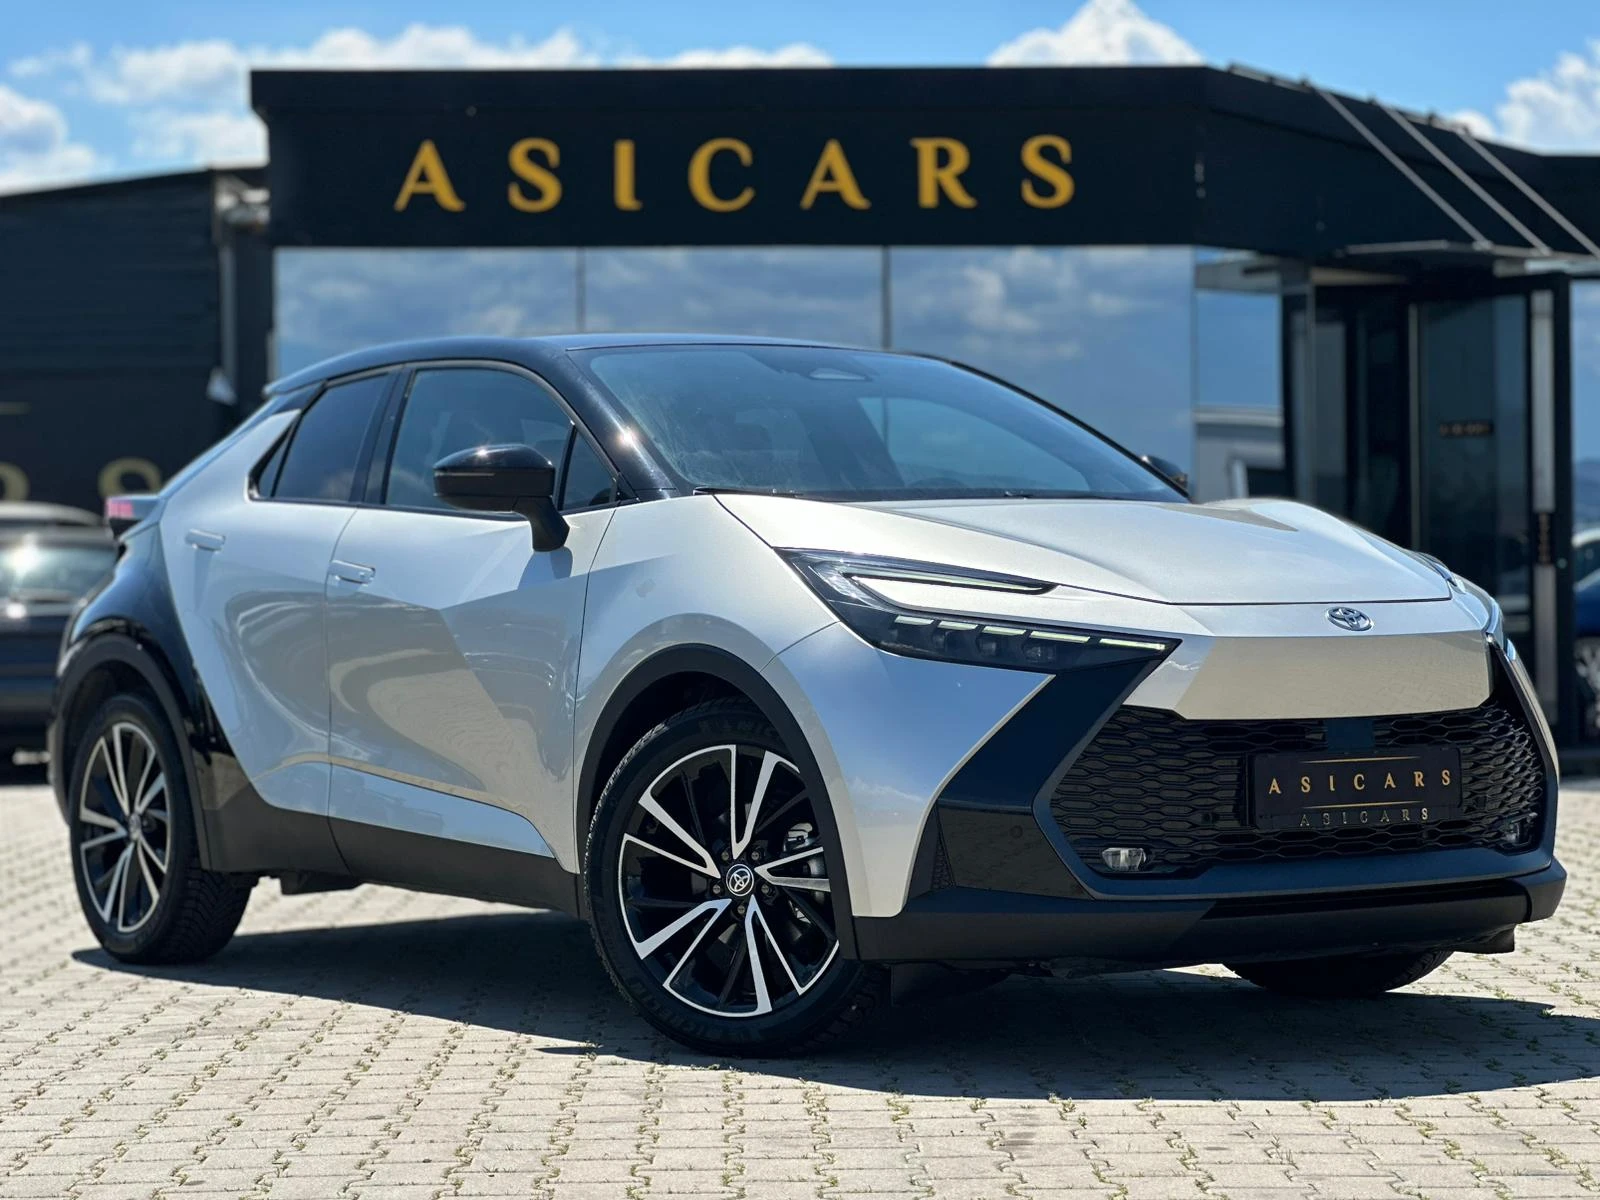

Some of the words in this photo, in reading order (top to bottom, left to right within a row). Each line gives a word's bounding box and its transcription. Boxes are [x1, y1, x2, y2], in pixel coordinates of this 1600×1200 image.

[394, 135, 1075, 212] ASICARS
[1268, 769, 1451, 794] ASICARS
[1300, 807, 1429, 827] ASICARS
